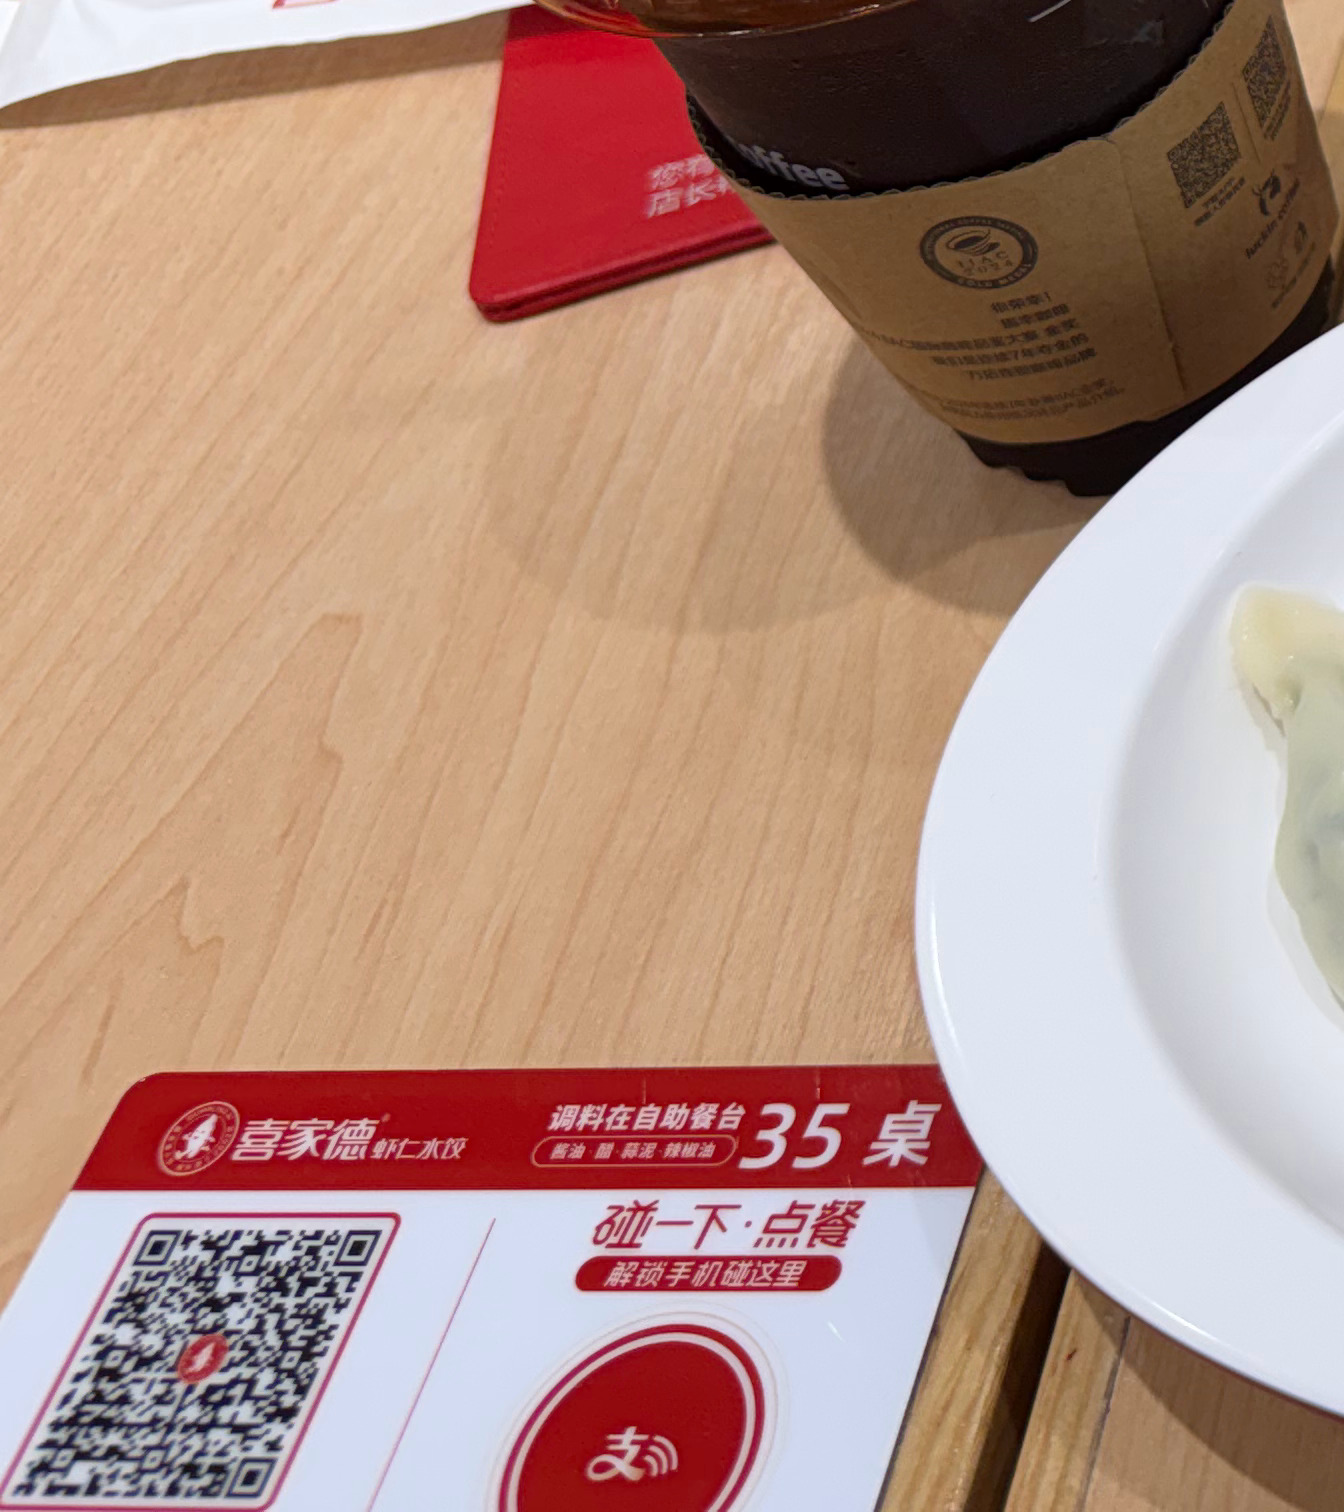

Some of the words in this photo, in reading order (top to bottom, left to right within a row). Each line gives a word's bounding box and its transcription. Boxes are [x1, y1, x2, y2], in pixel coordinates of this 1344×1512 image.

[548, 1102, 746, 1131] 调料在自助餐台
[738, 1102, 851, 1170] 35
[862, 1099, 942, 1168] 桌
[231, 1117, 380, 1161] 喜家德
[371, 1136, 469, 1161] 虾仁水饺
[604, 1260, 807, 1288] 解锁手机碰这里
